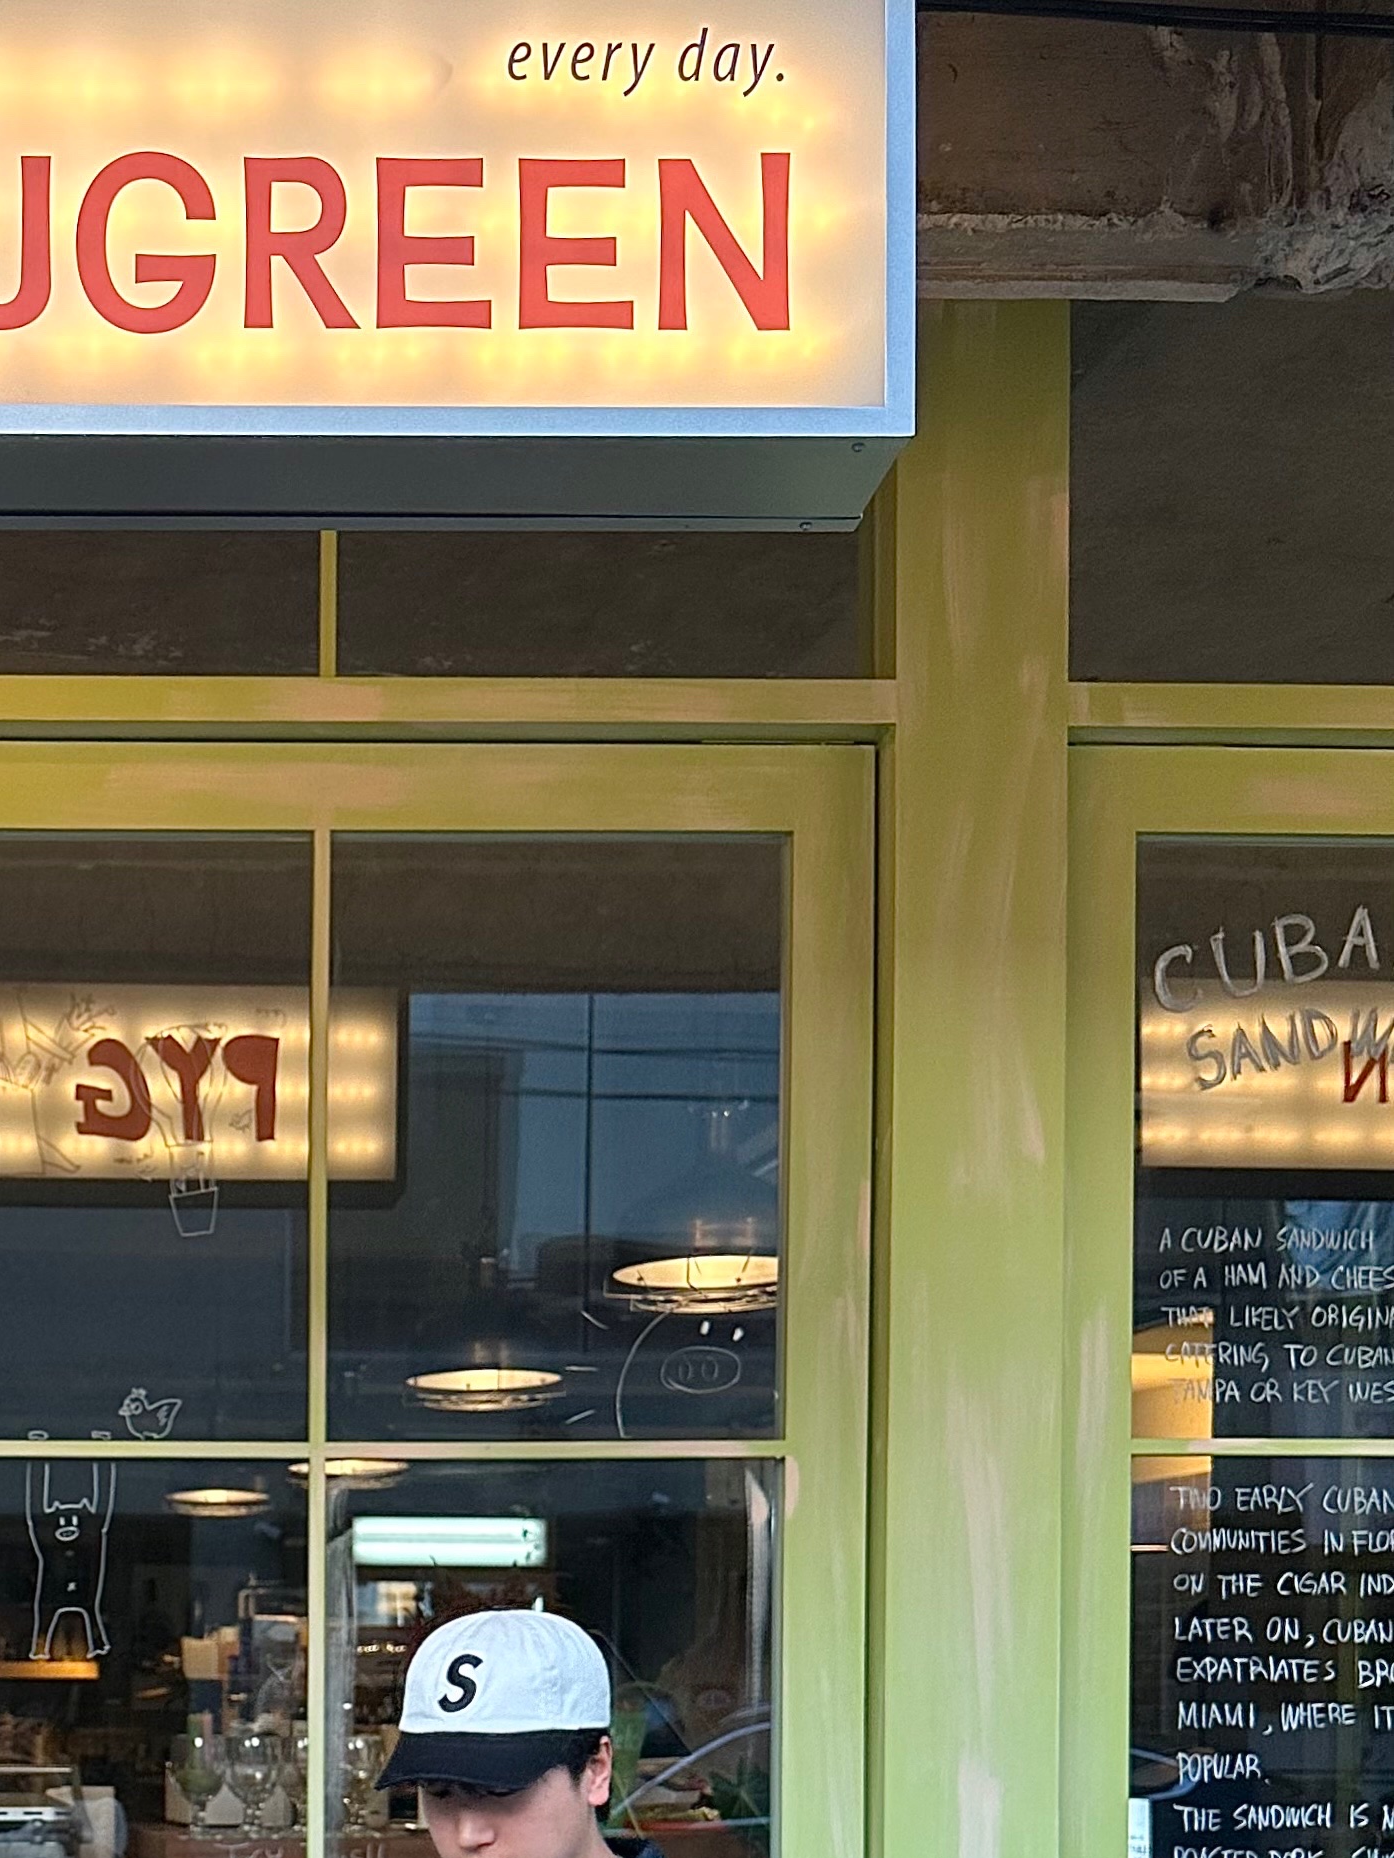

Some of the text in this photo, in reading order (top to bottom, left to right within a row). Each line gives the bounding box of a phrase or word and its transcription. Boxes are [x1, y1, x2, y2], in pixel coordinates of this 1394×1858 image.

[508, 28, 786, 99] every day.
[1154, 905, 1394, 1013] CUBA
[1187, 1006, 1394, 1091] SANDW
[1159, 1225, 1374, 1253] A CUBAN SANDWICH
[1159, 1268, 1187, 1290] OF
[1193, 1266, 1207, 1290] A
[1224, 1261, 1267, 1290] HAM
[1278, 1263, 1321, 1289] AND
[1161, 1306, 1213, 1328] THAT
[1230, 1305, 1300, 1332] LIKELY
[1164, 1341, 1269, 1373] CATERING
[1283, 1343, 1318, 1371] TO
[1250, 1380, 1282, 1403] OR
[1292, 1379, 1340, 1405] KEY
[1169, 1485, 1222, 1511] TWO
[1234, 1482, 1314, 1515] EARLY
[1170, 1527, 1307, 1556] COMMUNITIES
[1324, 1529, 1344, 1556] IN
[1173, 1570, 1394, 1600] ON THE CIGAR IND
[1174, 1616, 1253, 1643] LATER
[1322, 1618, 1394, 1645] CUBAN
[437, 1654, 483, 1712] S
[1176, 1655, 1336, 1684] EXPATRIATES
[1280, 1702, 1356, 1732] WHERE
[1374, 1704, 1394, 1731] IT
[1173, 1803, 1223, 1833] THE
[1233, 1802, 1332, 1831] SANDWICH
[1350, 1802, 1370, 1829] IS
